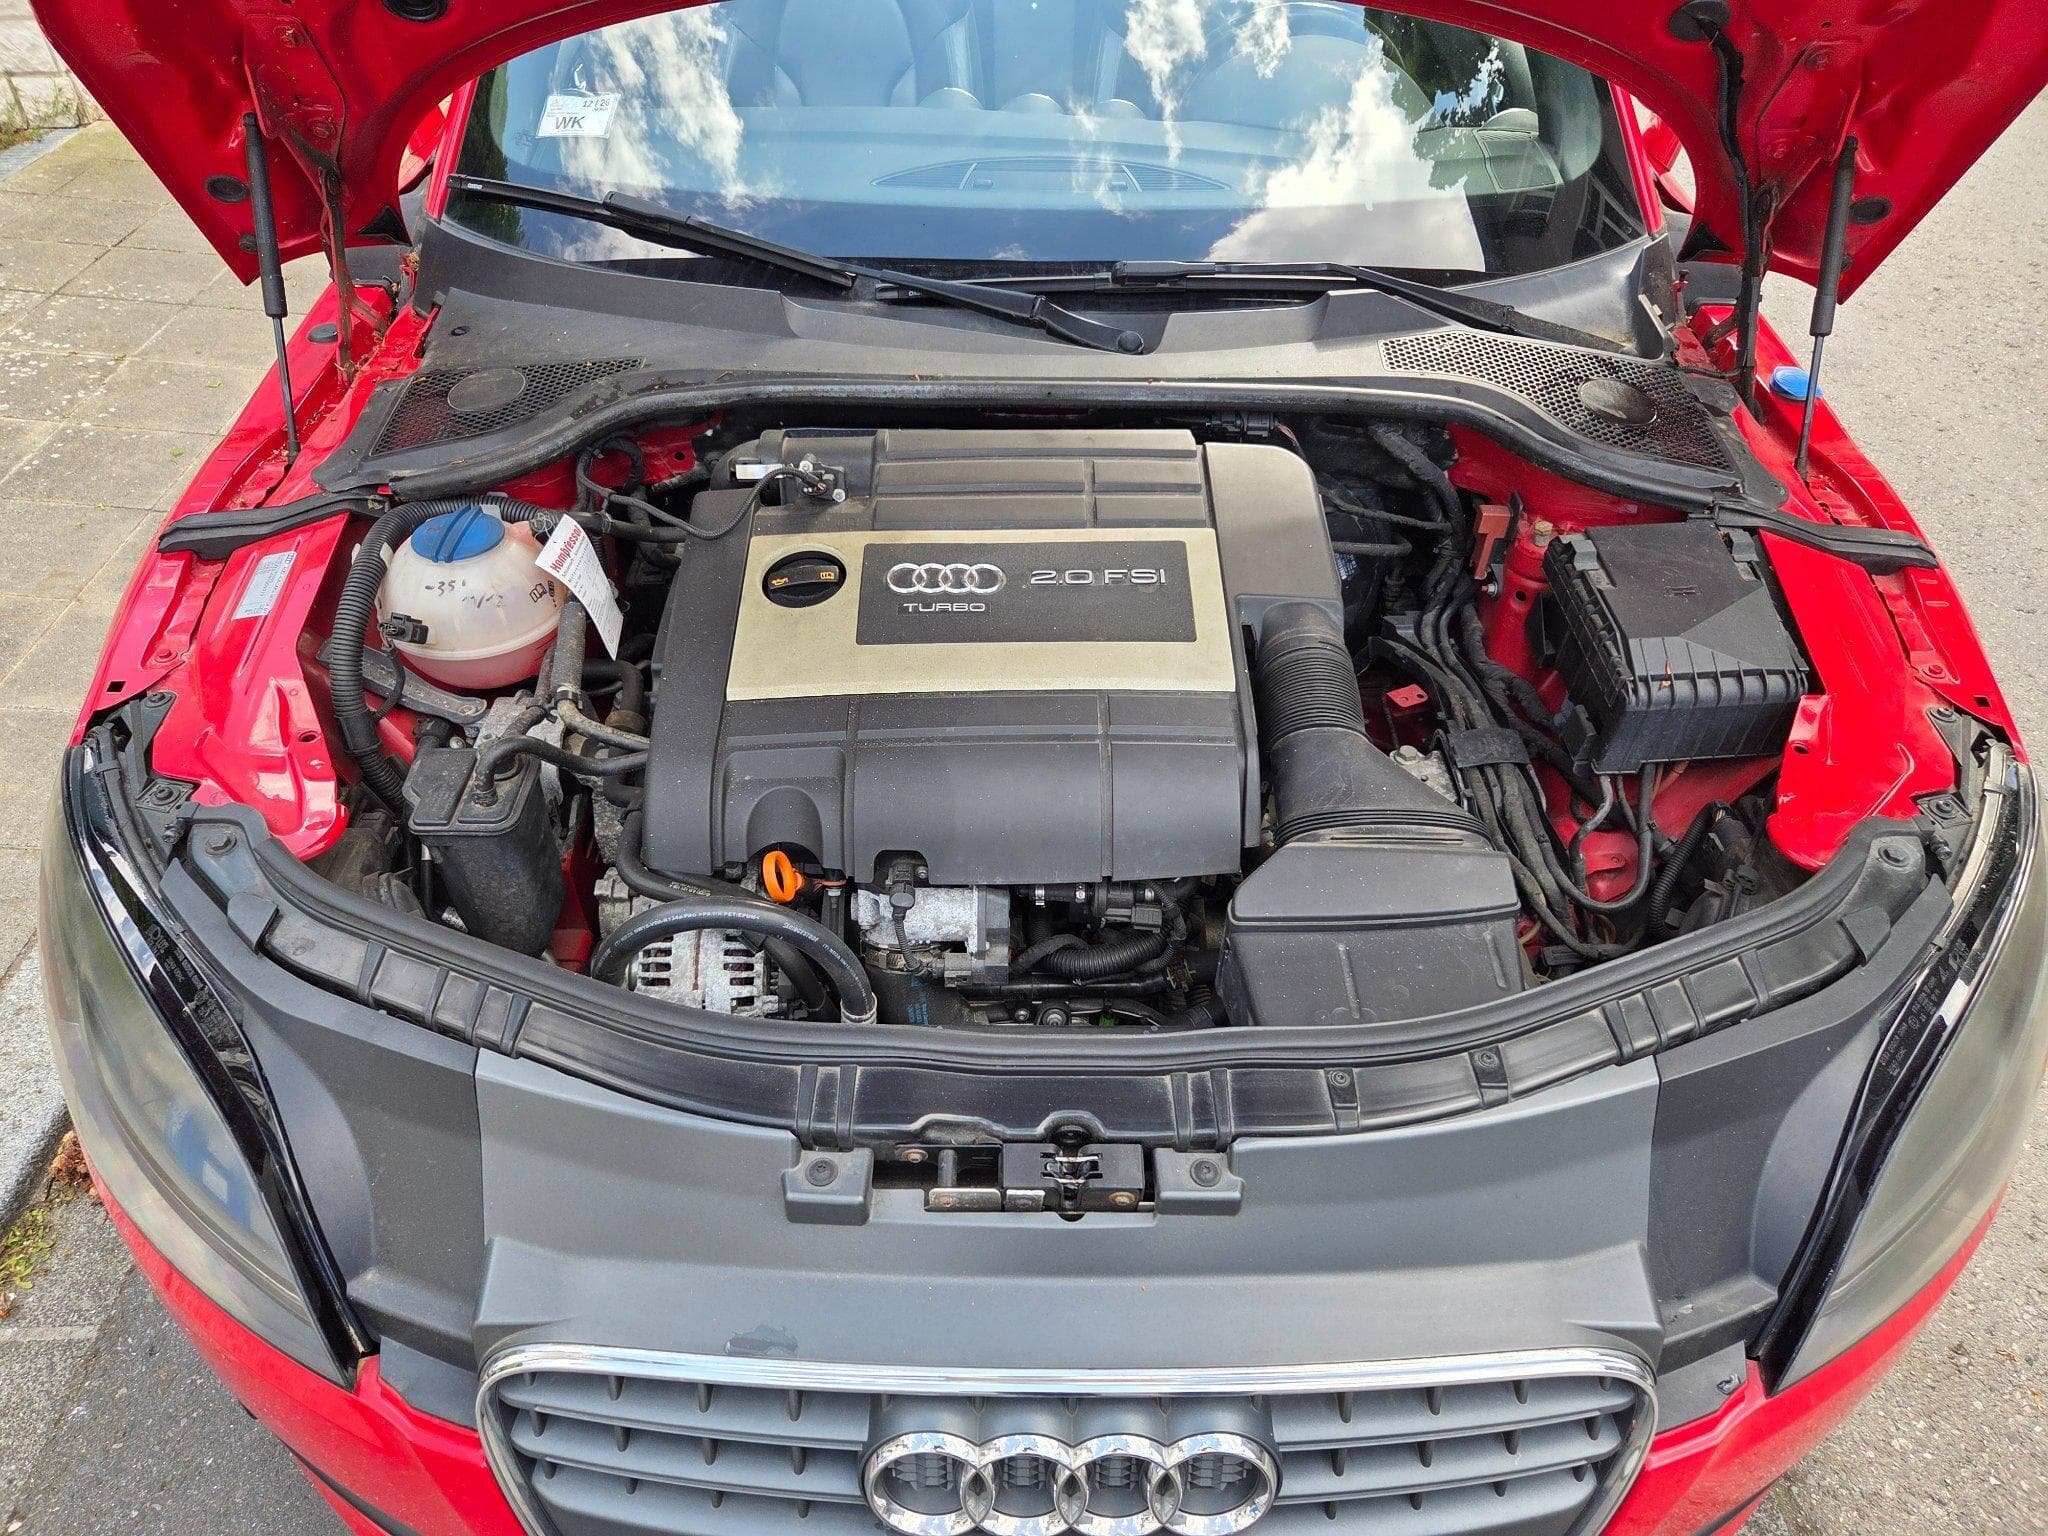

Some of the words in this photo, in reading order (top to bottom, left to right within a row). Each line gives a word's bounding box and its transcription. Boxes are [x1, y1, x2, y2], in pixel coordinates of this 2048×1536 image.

[555, 115, 586, 130] WK
[1030, 569, 1093, 585] 2.0
[1103, 568, 1166, 585] FSI
[902, 602, 986, 613] TURBO
